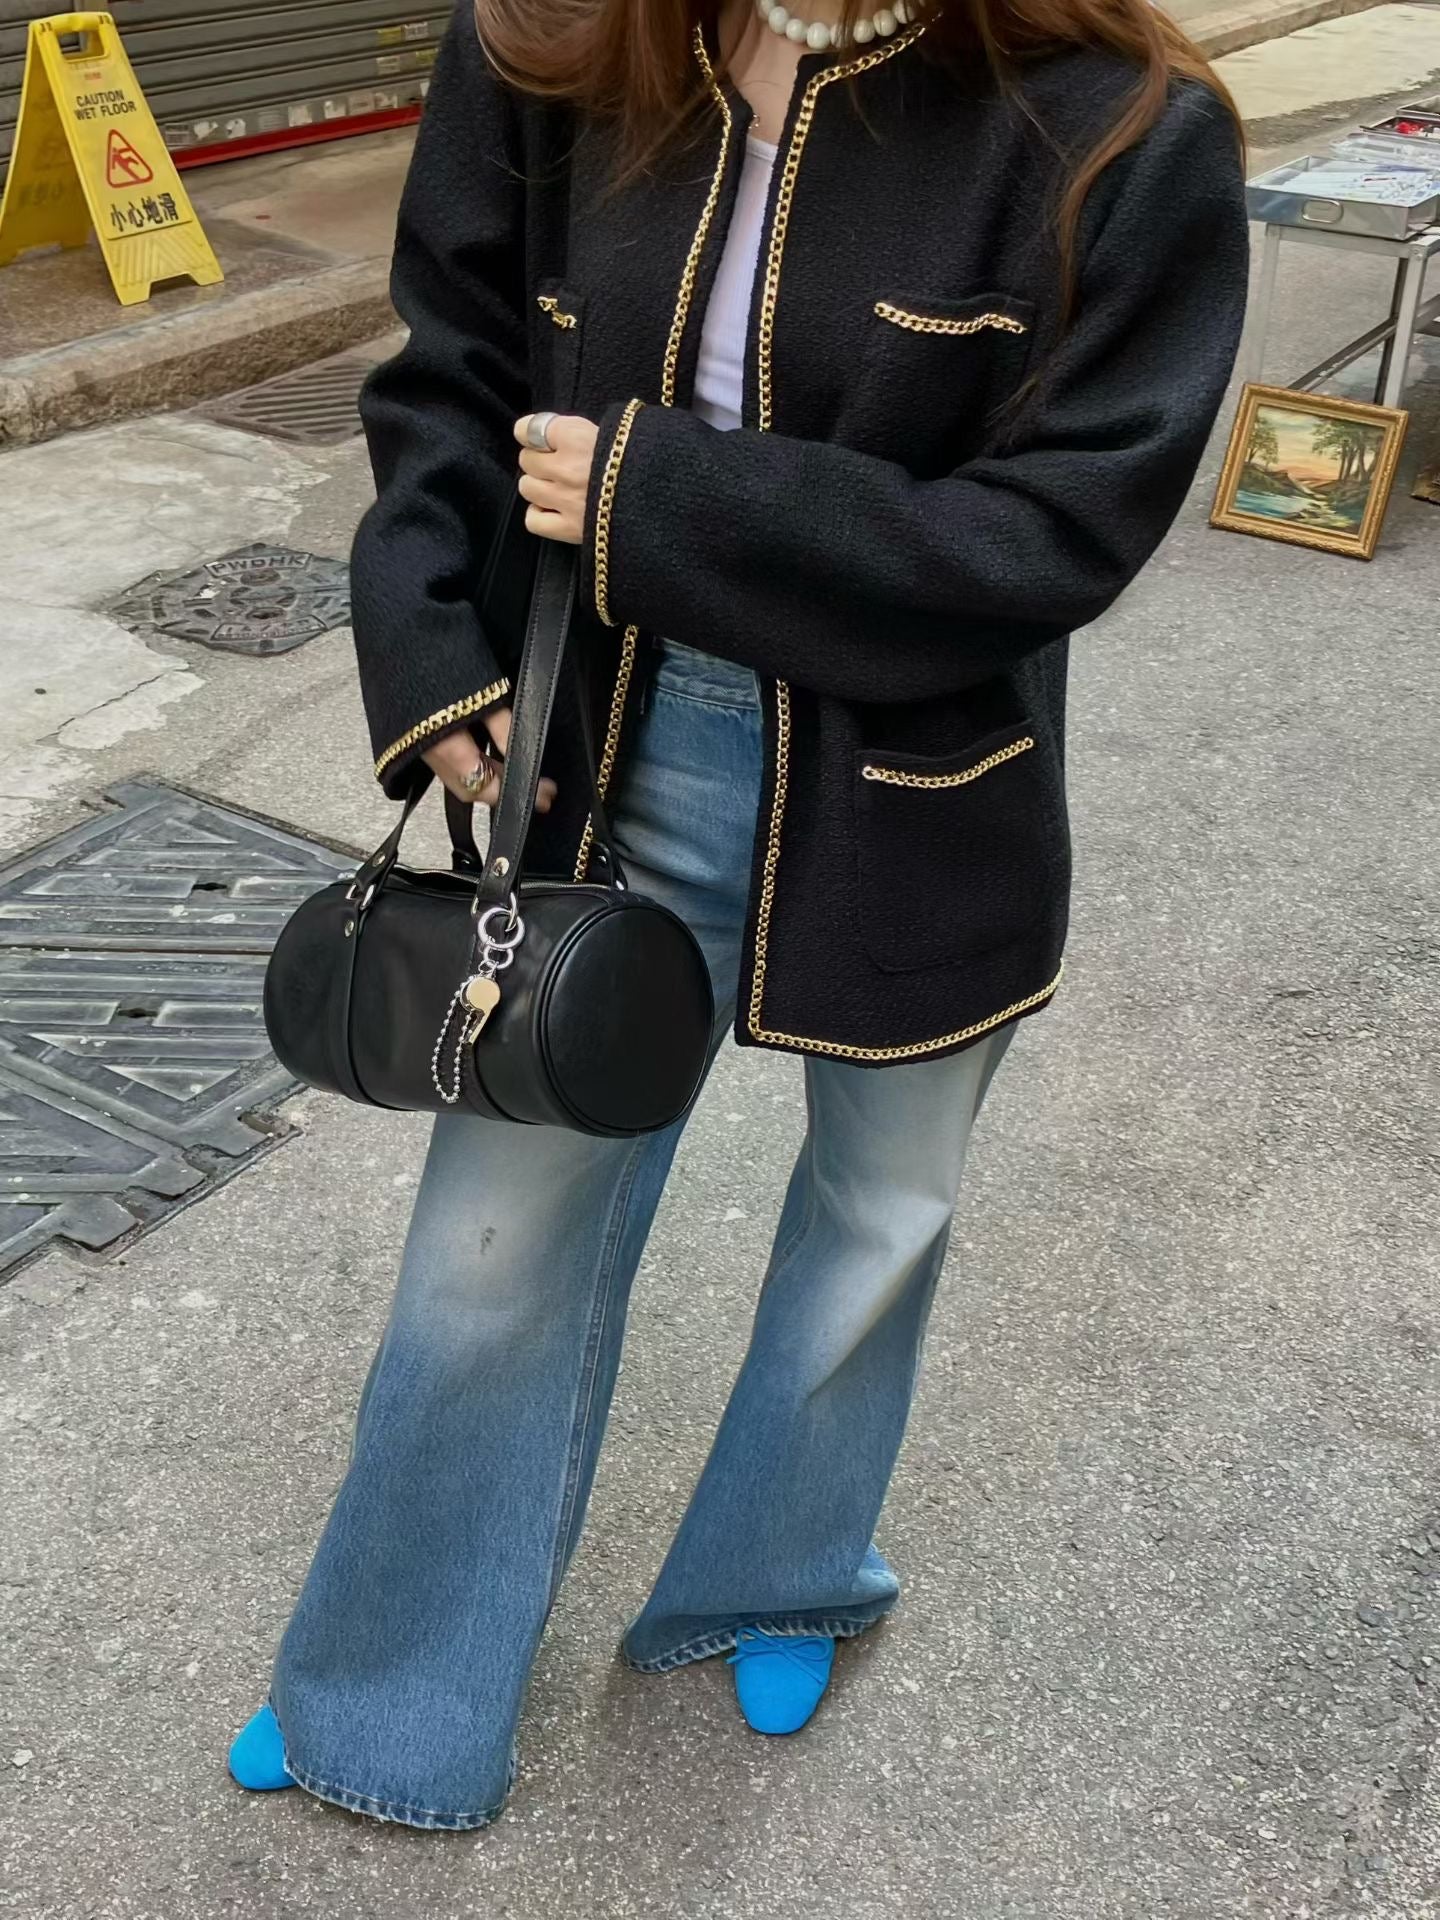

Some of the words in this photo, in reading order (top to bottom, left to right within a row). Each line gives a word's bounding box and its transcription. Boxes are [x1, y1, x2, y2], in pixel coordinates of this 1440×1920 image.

[76, 90, 125, 107] CAUTION
[74, 107, 97, 120] WET
[101, 101, 137, 117] FLOOR
[110, 192, 179, 232] 小心地滑
